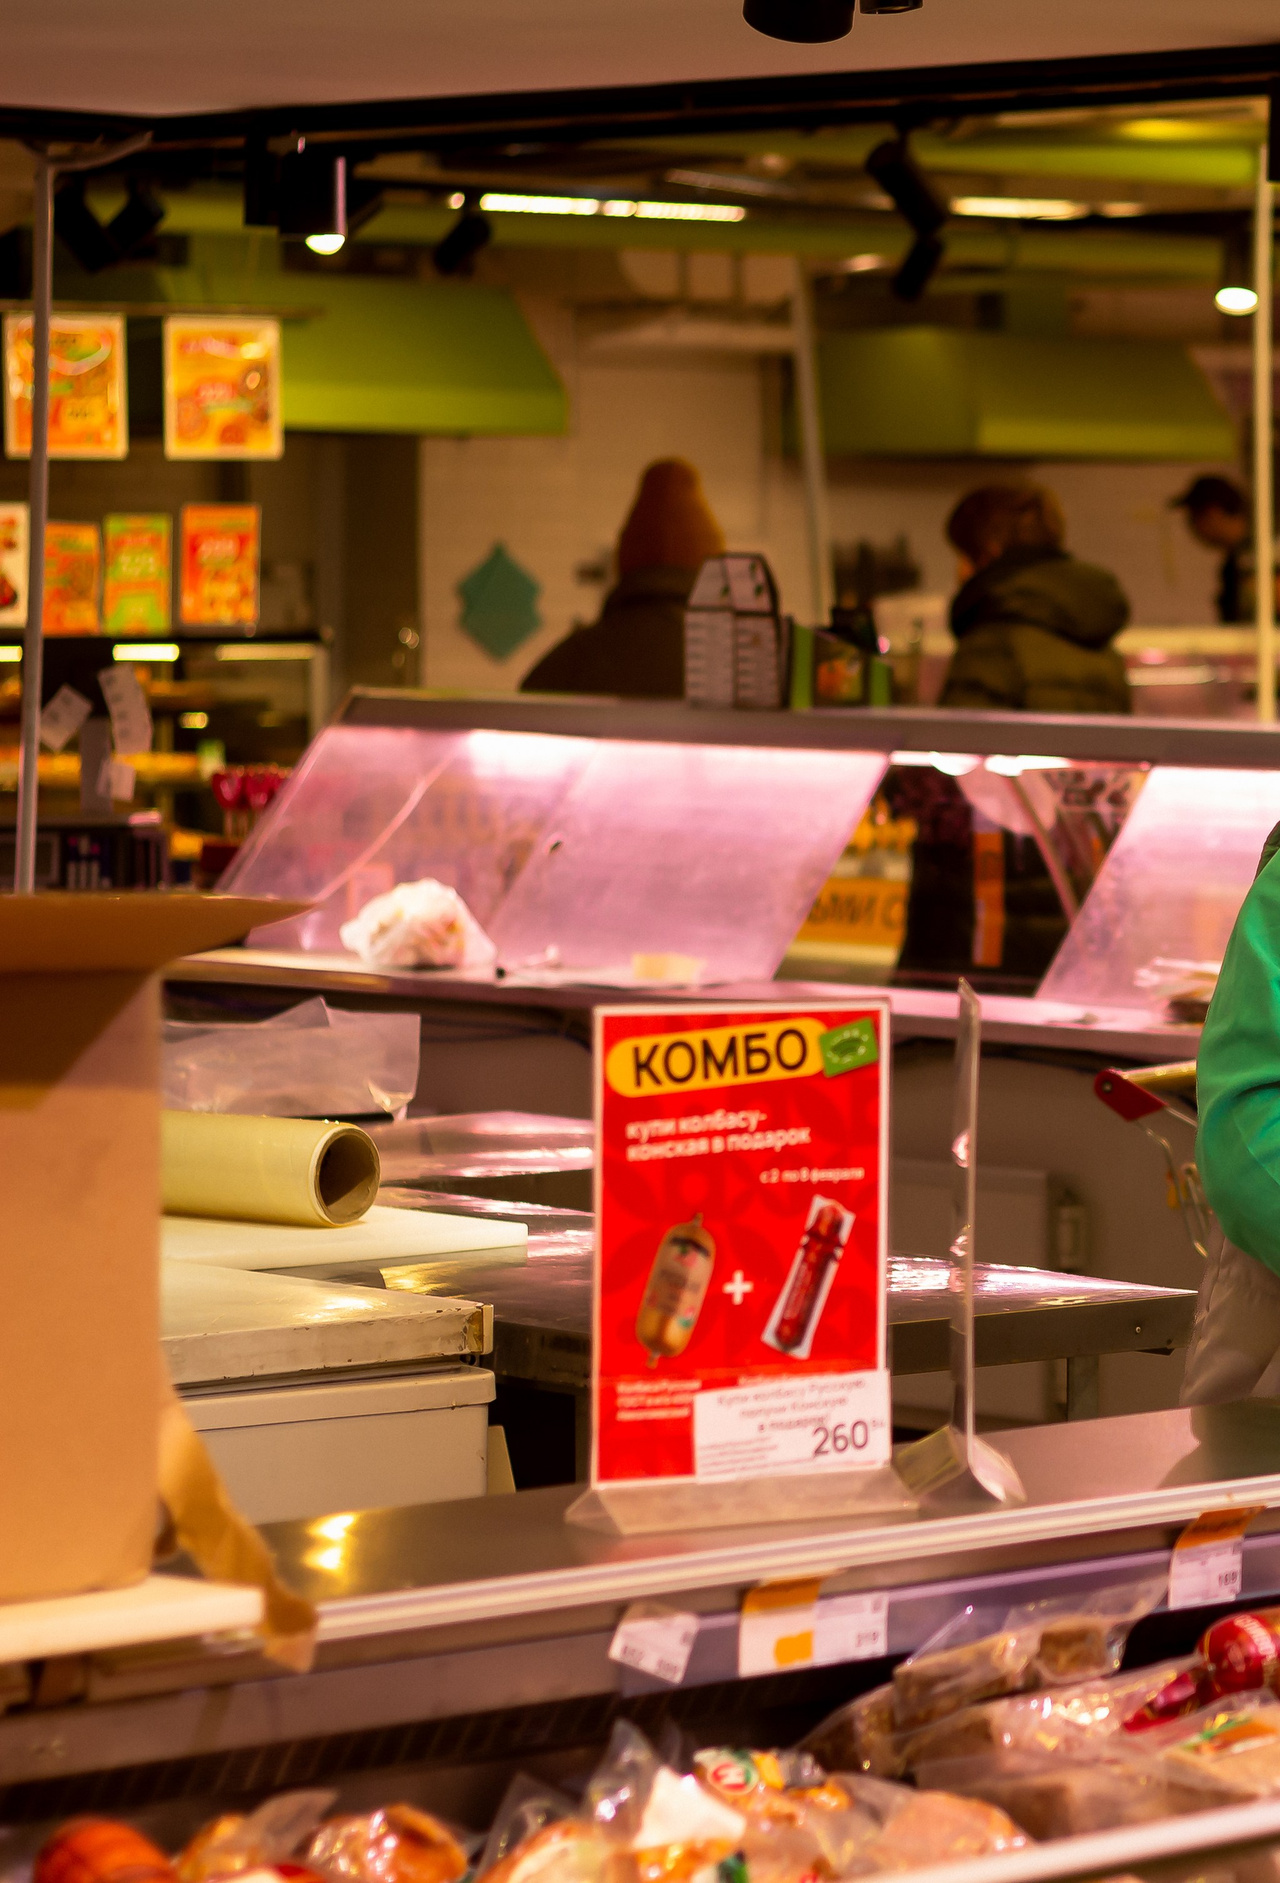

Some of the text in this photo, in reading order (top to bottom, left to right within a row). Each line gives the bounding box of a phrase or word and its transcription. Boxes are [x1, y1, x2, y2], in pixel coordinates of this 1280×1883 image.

[633, 1028, 807, 1087] КОМБО
[626, 1117, 676, 1143] купи
[626, 1127, 811, 1162] конская в подарок
[810, 1167, 865, 1184] февраля
[812, 1420, 869, 1457] 260
